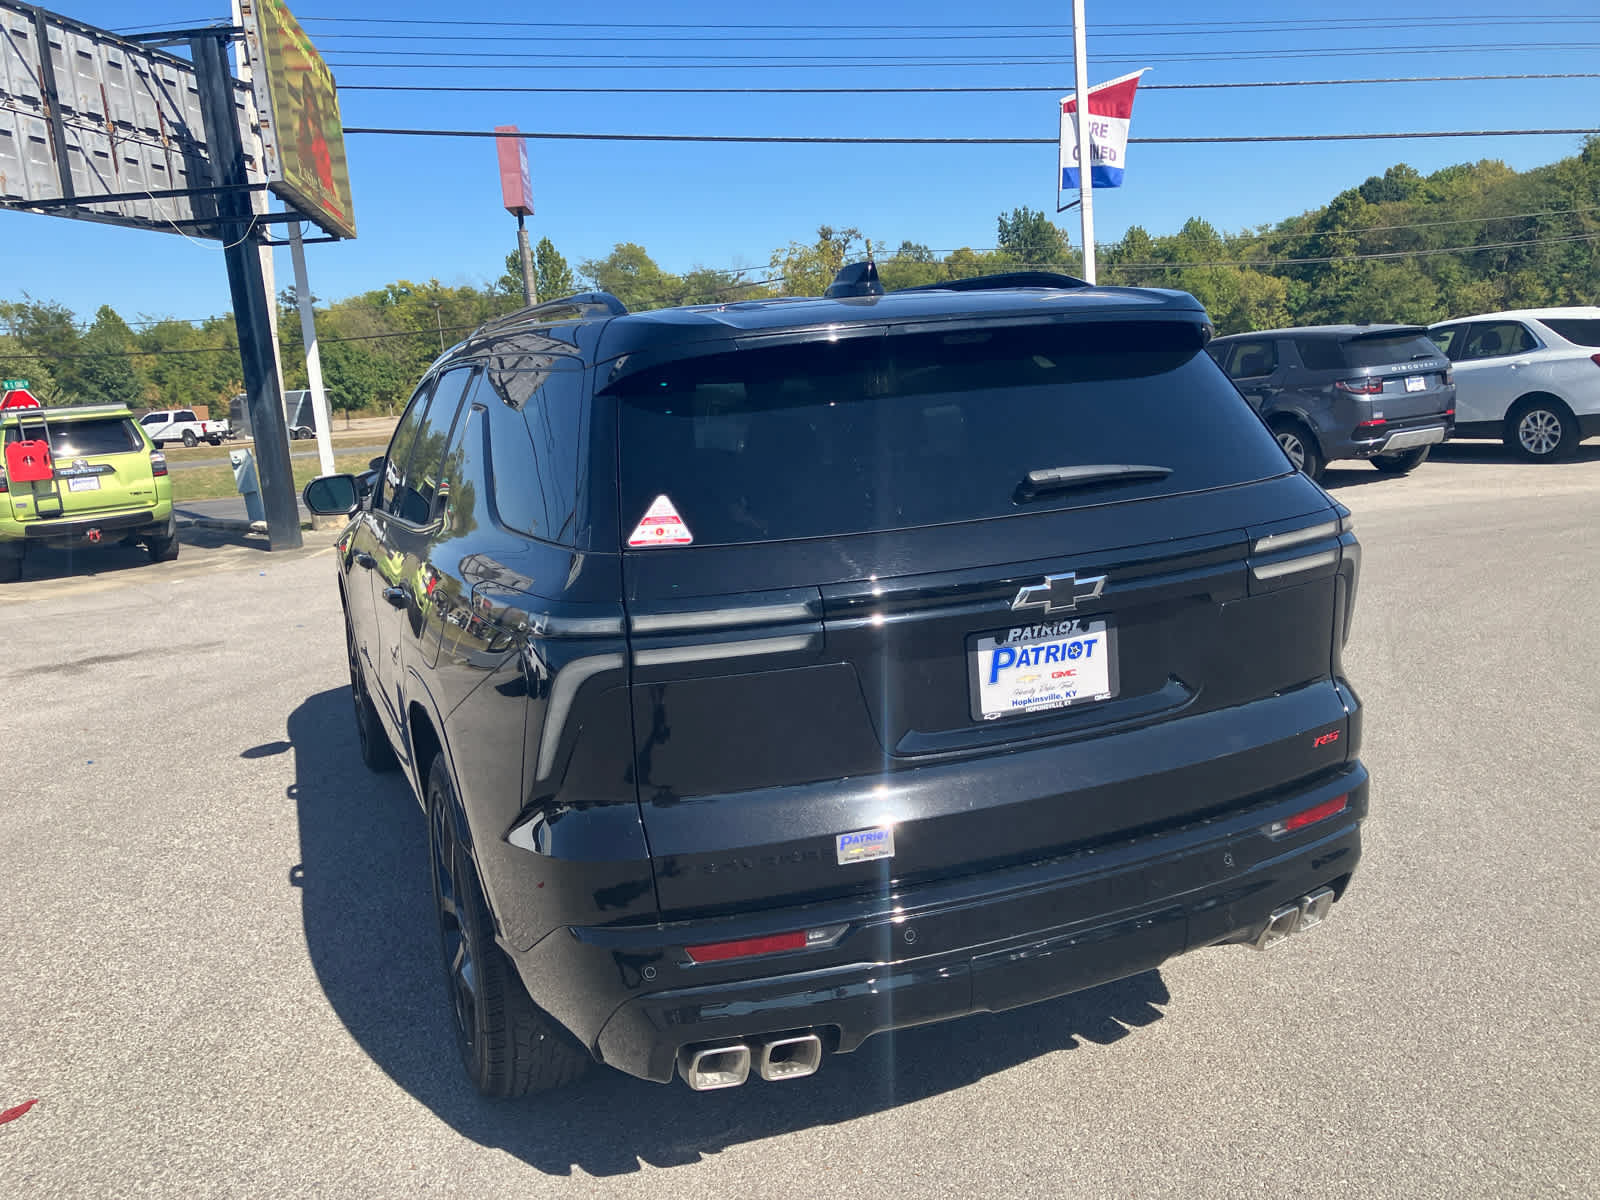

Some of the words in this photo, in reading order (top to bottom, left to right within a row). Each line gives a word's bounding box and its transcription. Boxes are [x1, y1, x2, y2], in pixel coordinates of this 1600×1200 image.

[1088, 121, 1109, 138] RE
[1072, 144, 1117, 161] ONED
[1007, 619, 1081, 642] PATRIOT
[988, 639, 1098, 685] PATRIOT
[1051, 668, 1078, 679] GMC
[1012, 693, 1064, 707] Hopkinsville,
[1065, 690, 1077, 698] KY
[1313, 729, 1341, 748] RS
